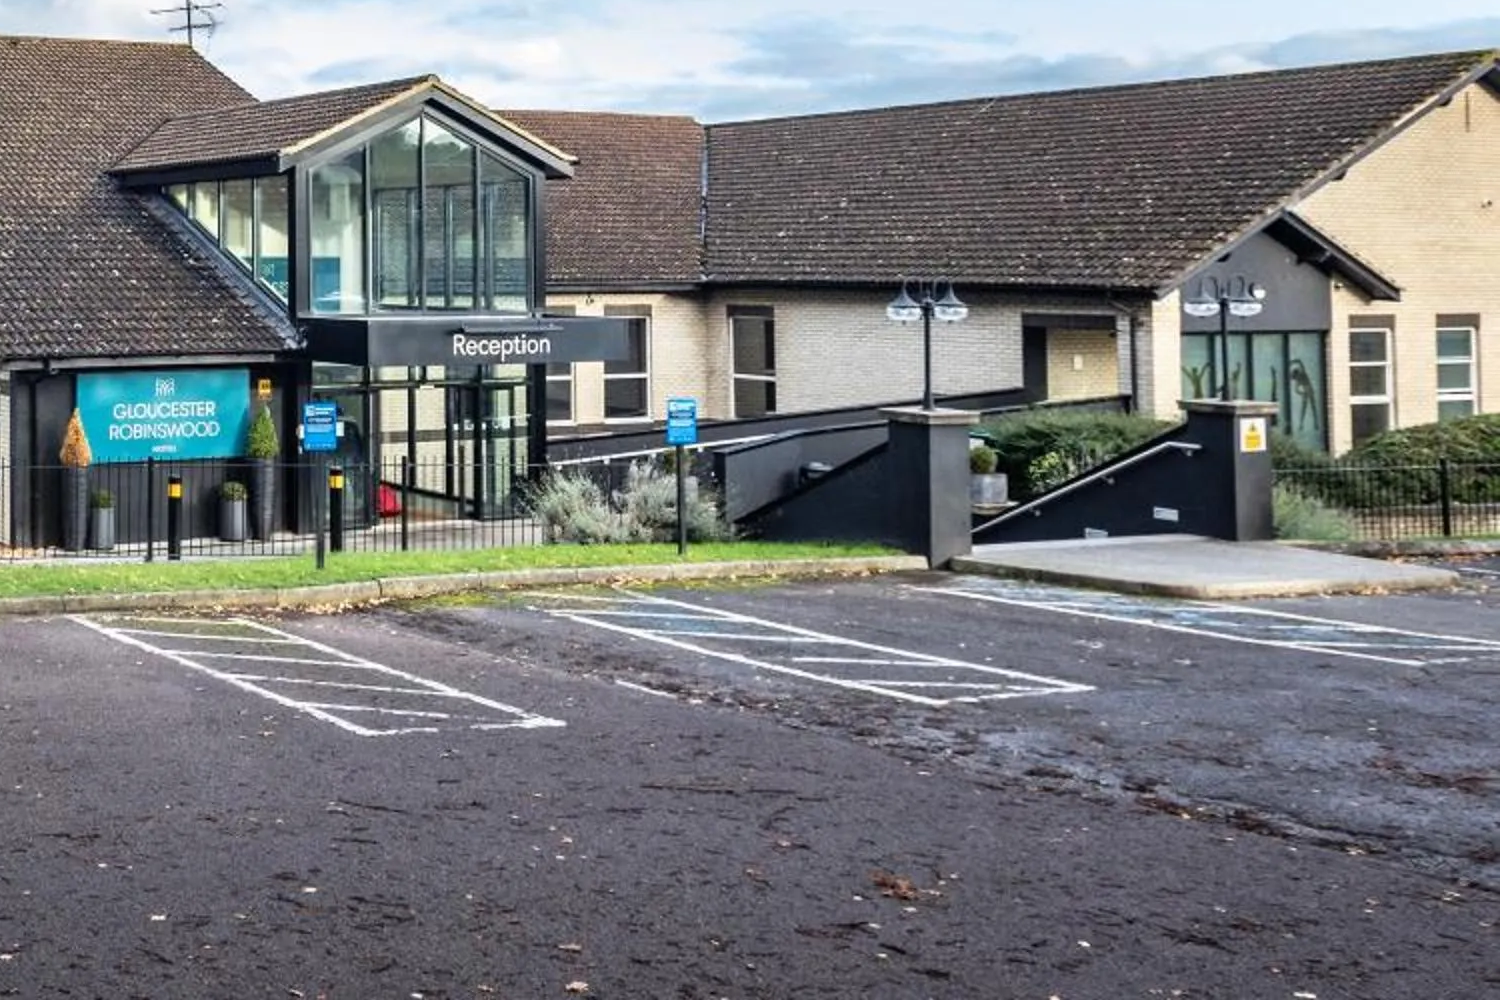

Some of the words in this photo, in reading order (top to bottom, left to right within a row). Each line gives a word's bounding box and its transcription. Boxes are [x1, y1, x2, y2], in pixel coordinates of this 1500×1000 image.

[453, 333, 550, 362] Reception
[113, 402, 216, 419] GLOUCESTER
[109, 421, 220, 440] ROBINSWOOD
